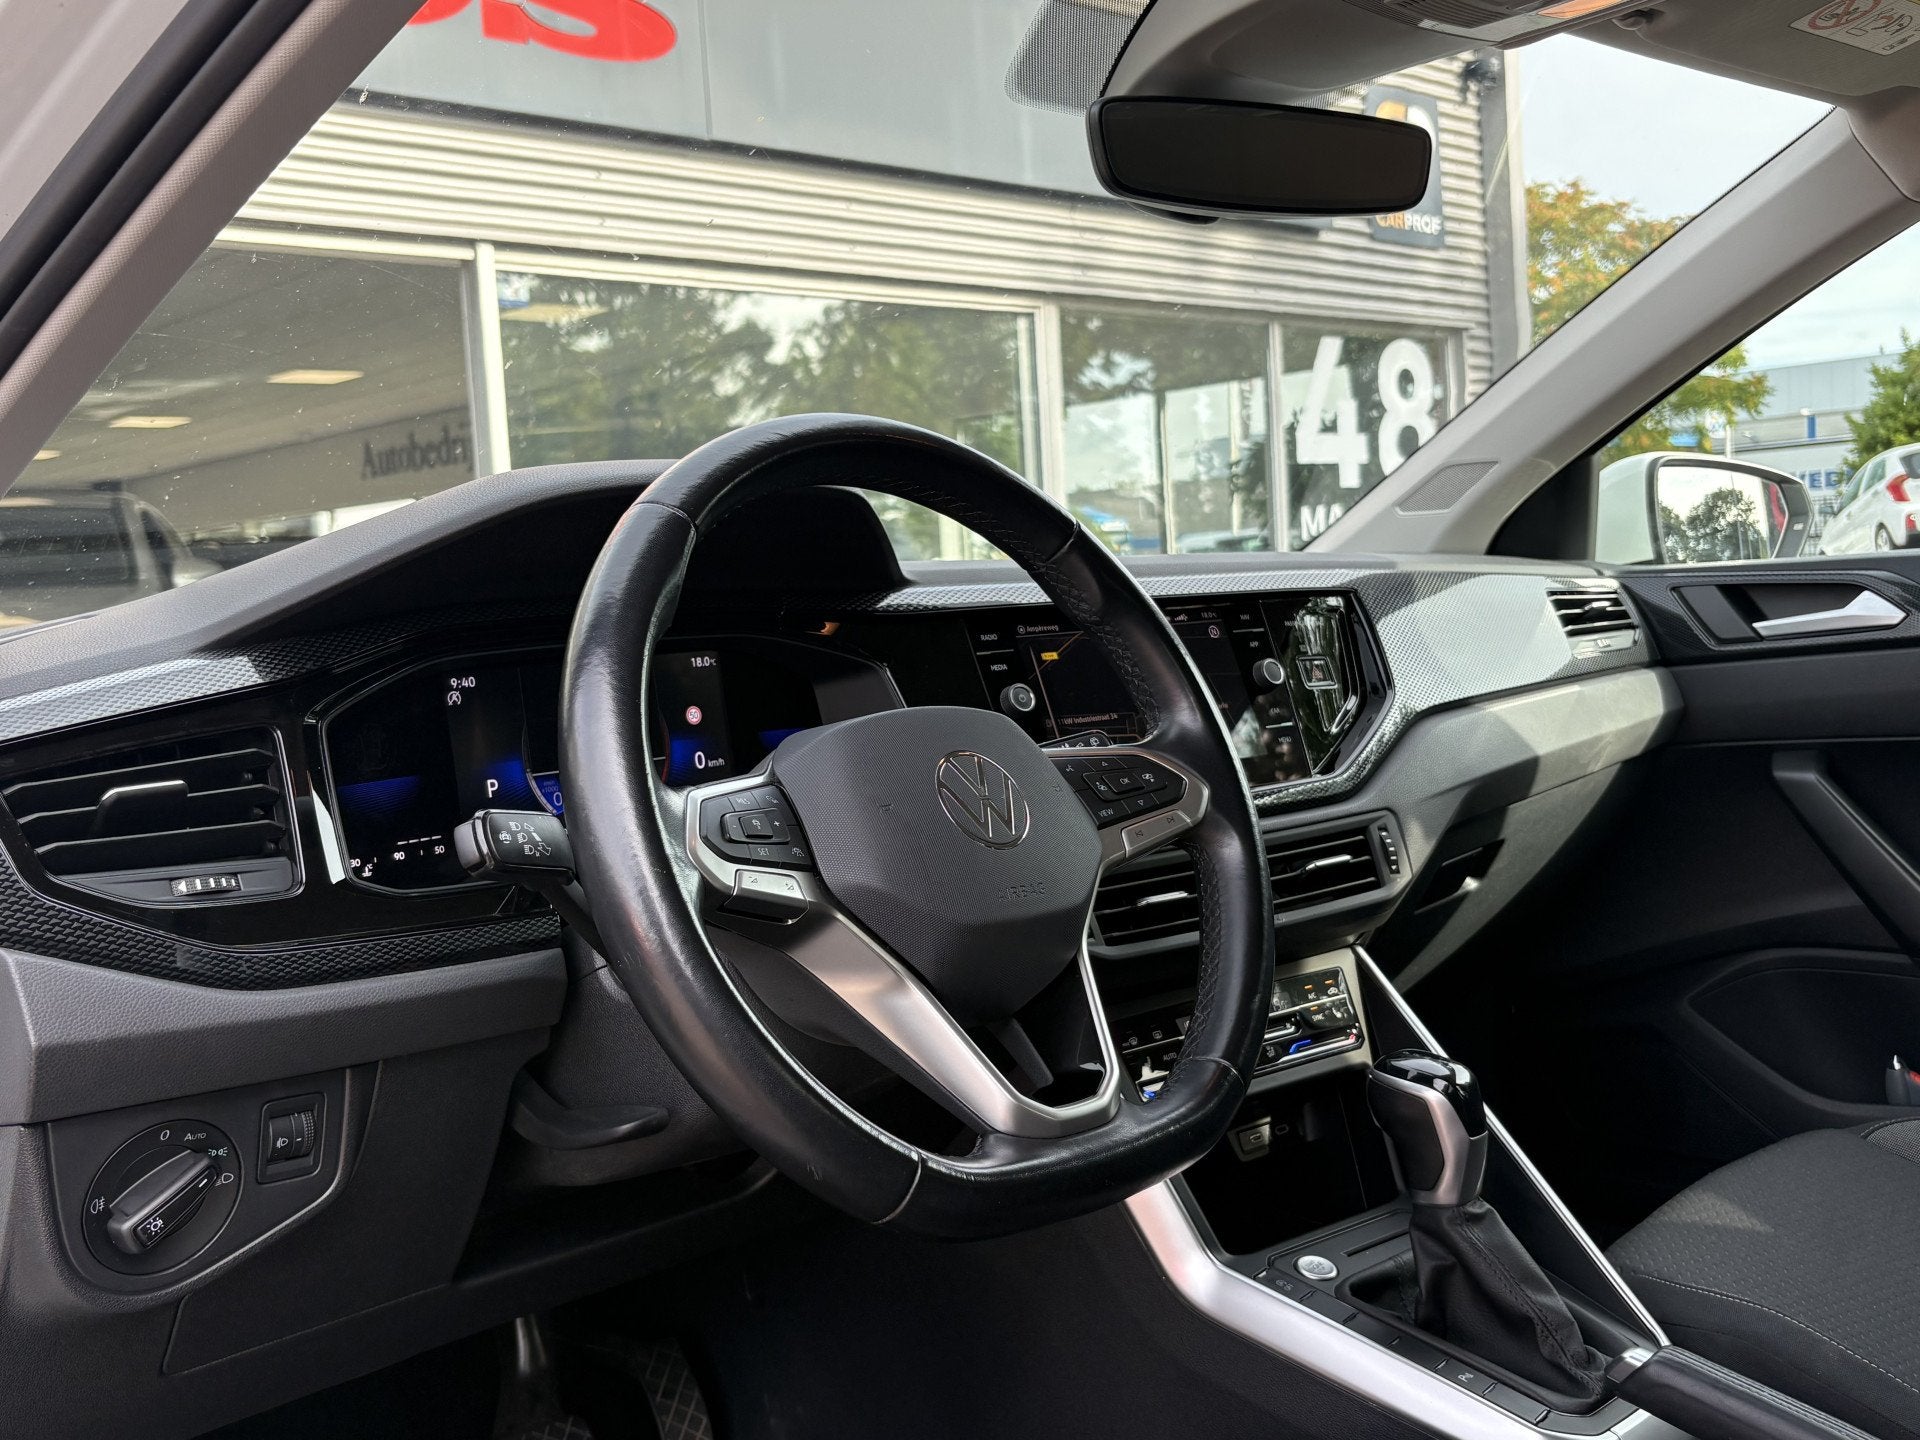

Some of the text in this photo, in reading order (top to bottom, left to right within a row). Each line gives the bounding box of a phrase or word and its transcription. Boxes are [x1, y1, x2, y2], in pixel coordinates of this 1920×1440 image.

[1296, 336, 1437, 489] 48
[990, 664, 1008, 672] MEDIA
[450, 676, 476, 689] 9:40
[695, 751, 725, 770] 0 km/h
[486, 778, 499, 799] P
[553, 791, 563, 807] 0
[394, 851, 405, 861] 90
[434, 845, 445, 854] 50
[1311, 1013, 1325, 1022] SYNC
[1163, 1051, 1178, 1061] AUTO
[160, 1130, 170, 1140] 0
